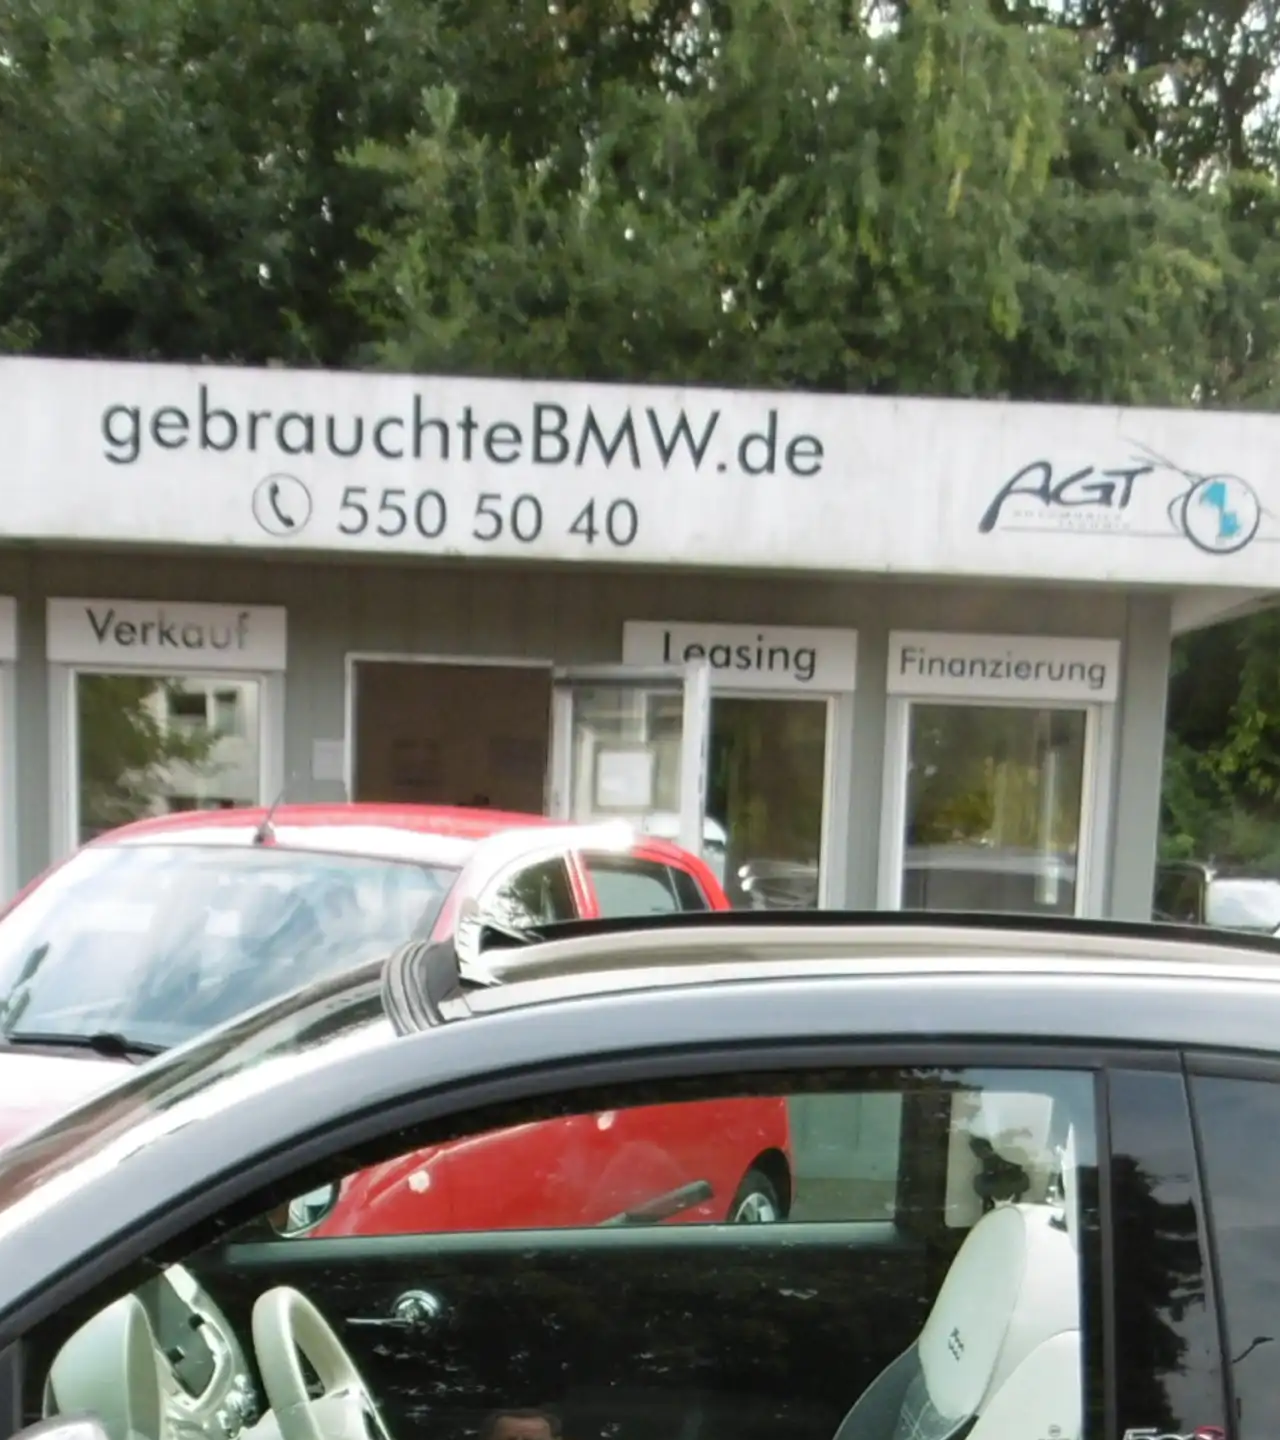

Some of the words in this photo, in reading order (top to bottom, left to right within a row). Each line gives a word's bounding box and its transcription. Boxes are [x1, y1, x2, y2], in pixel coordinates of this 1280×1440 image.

[101, 382, 825, 477] gebrauchteBMW.de
[338, 485, 447, 539] 550
[472, 492, 543, 543] 50
[567, 496, 639, 547] 40
[978, 460, 1154, 535] AGT
[84, 606, 250, 652] Verkauf
[900, 646, 1107, 690] Finanzierung
